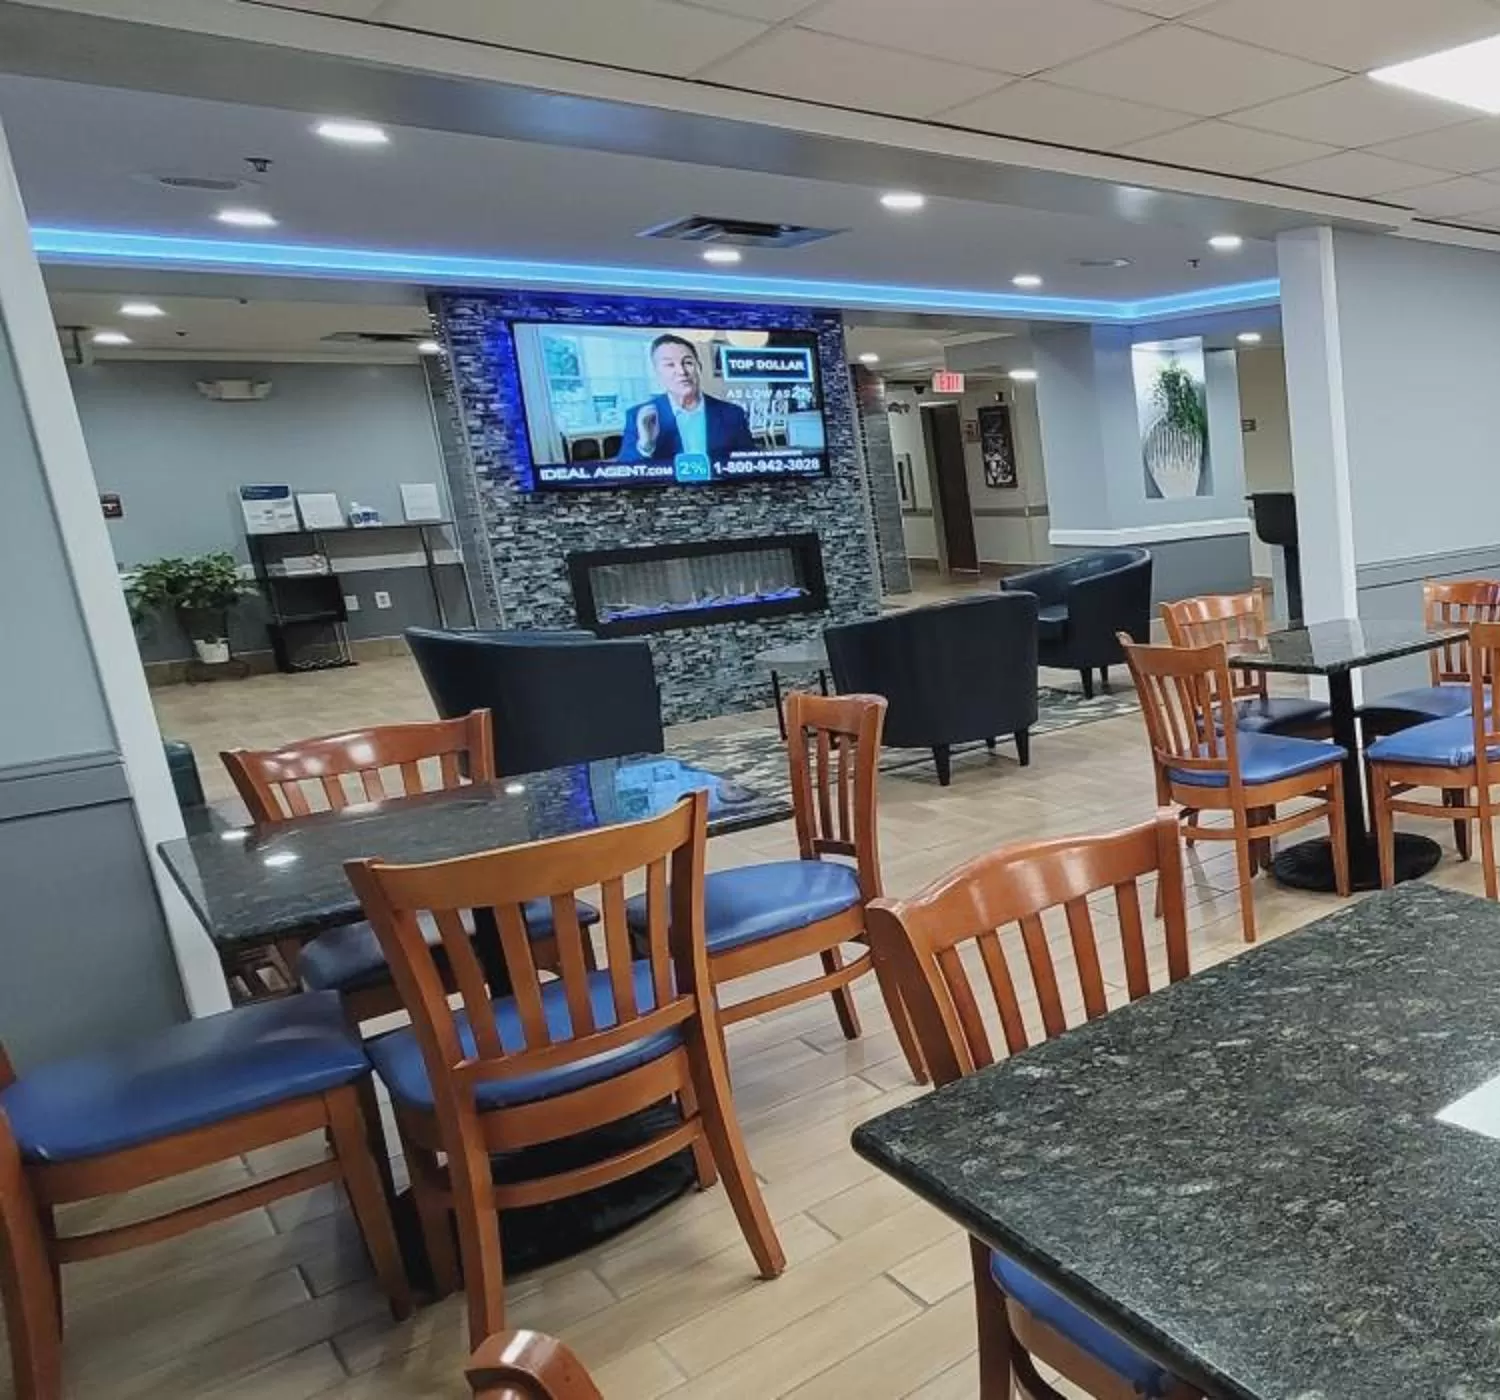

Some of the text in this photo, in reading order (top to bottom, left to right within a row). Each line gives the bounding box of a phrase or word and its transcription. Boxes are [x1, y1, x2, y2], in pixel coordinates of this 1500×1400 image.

[727, 359, 806, 371] TOP DOLLAR
[726, 388, 743, 399] AS
[745, 388, 773, 400] LOW
[775, 388, 791, 400] AS
[540, 465, 592, 481] IDEAL
[679, 461, 706, 475] 2%
